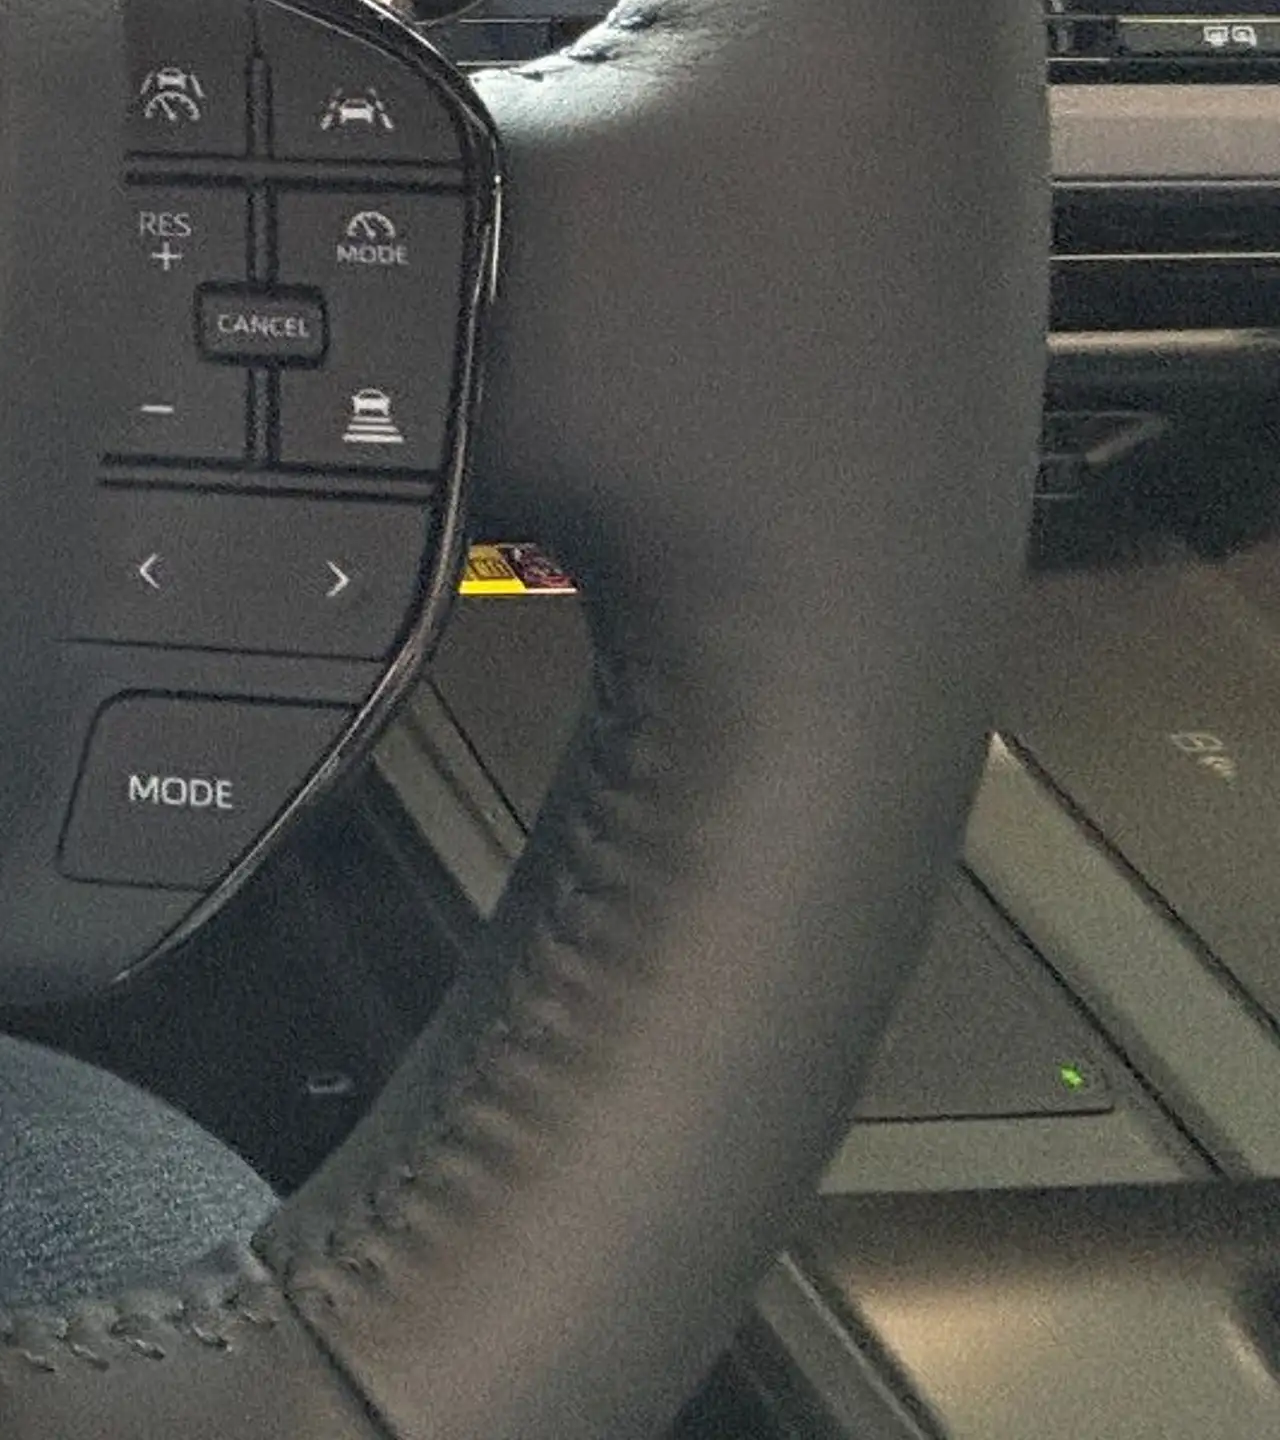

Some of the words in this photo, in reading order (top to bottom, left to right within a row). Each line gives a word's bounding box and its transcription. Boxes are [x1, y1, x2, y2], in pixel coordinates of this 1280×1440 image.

[140, 211, 191, 237] RES
[337, 244, 409, 265] MODE
[217, 314, 310, 338] CANCEL
[129, 774, 234, 809] MODE
